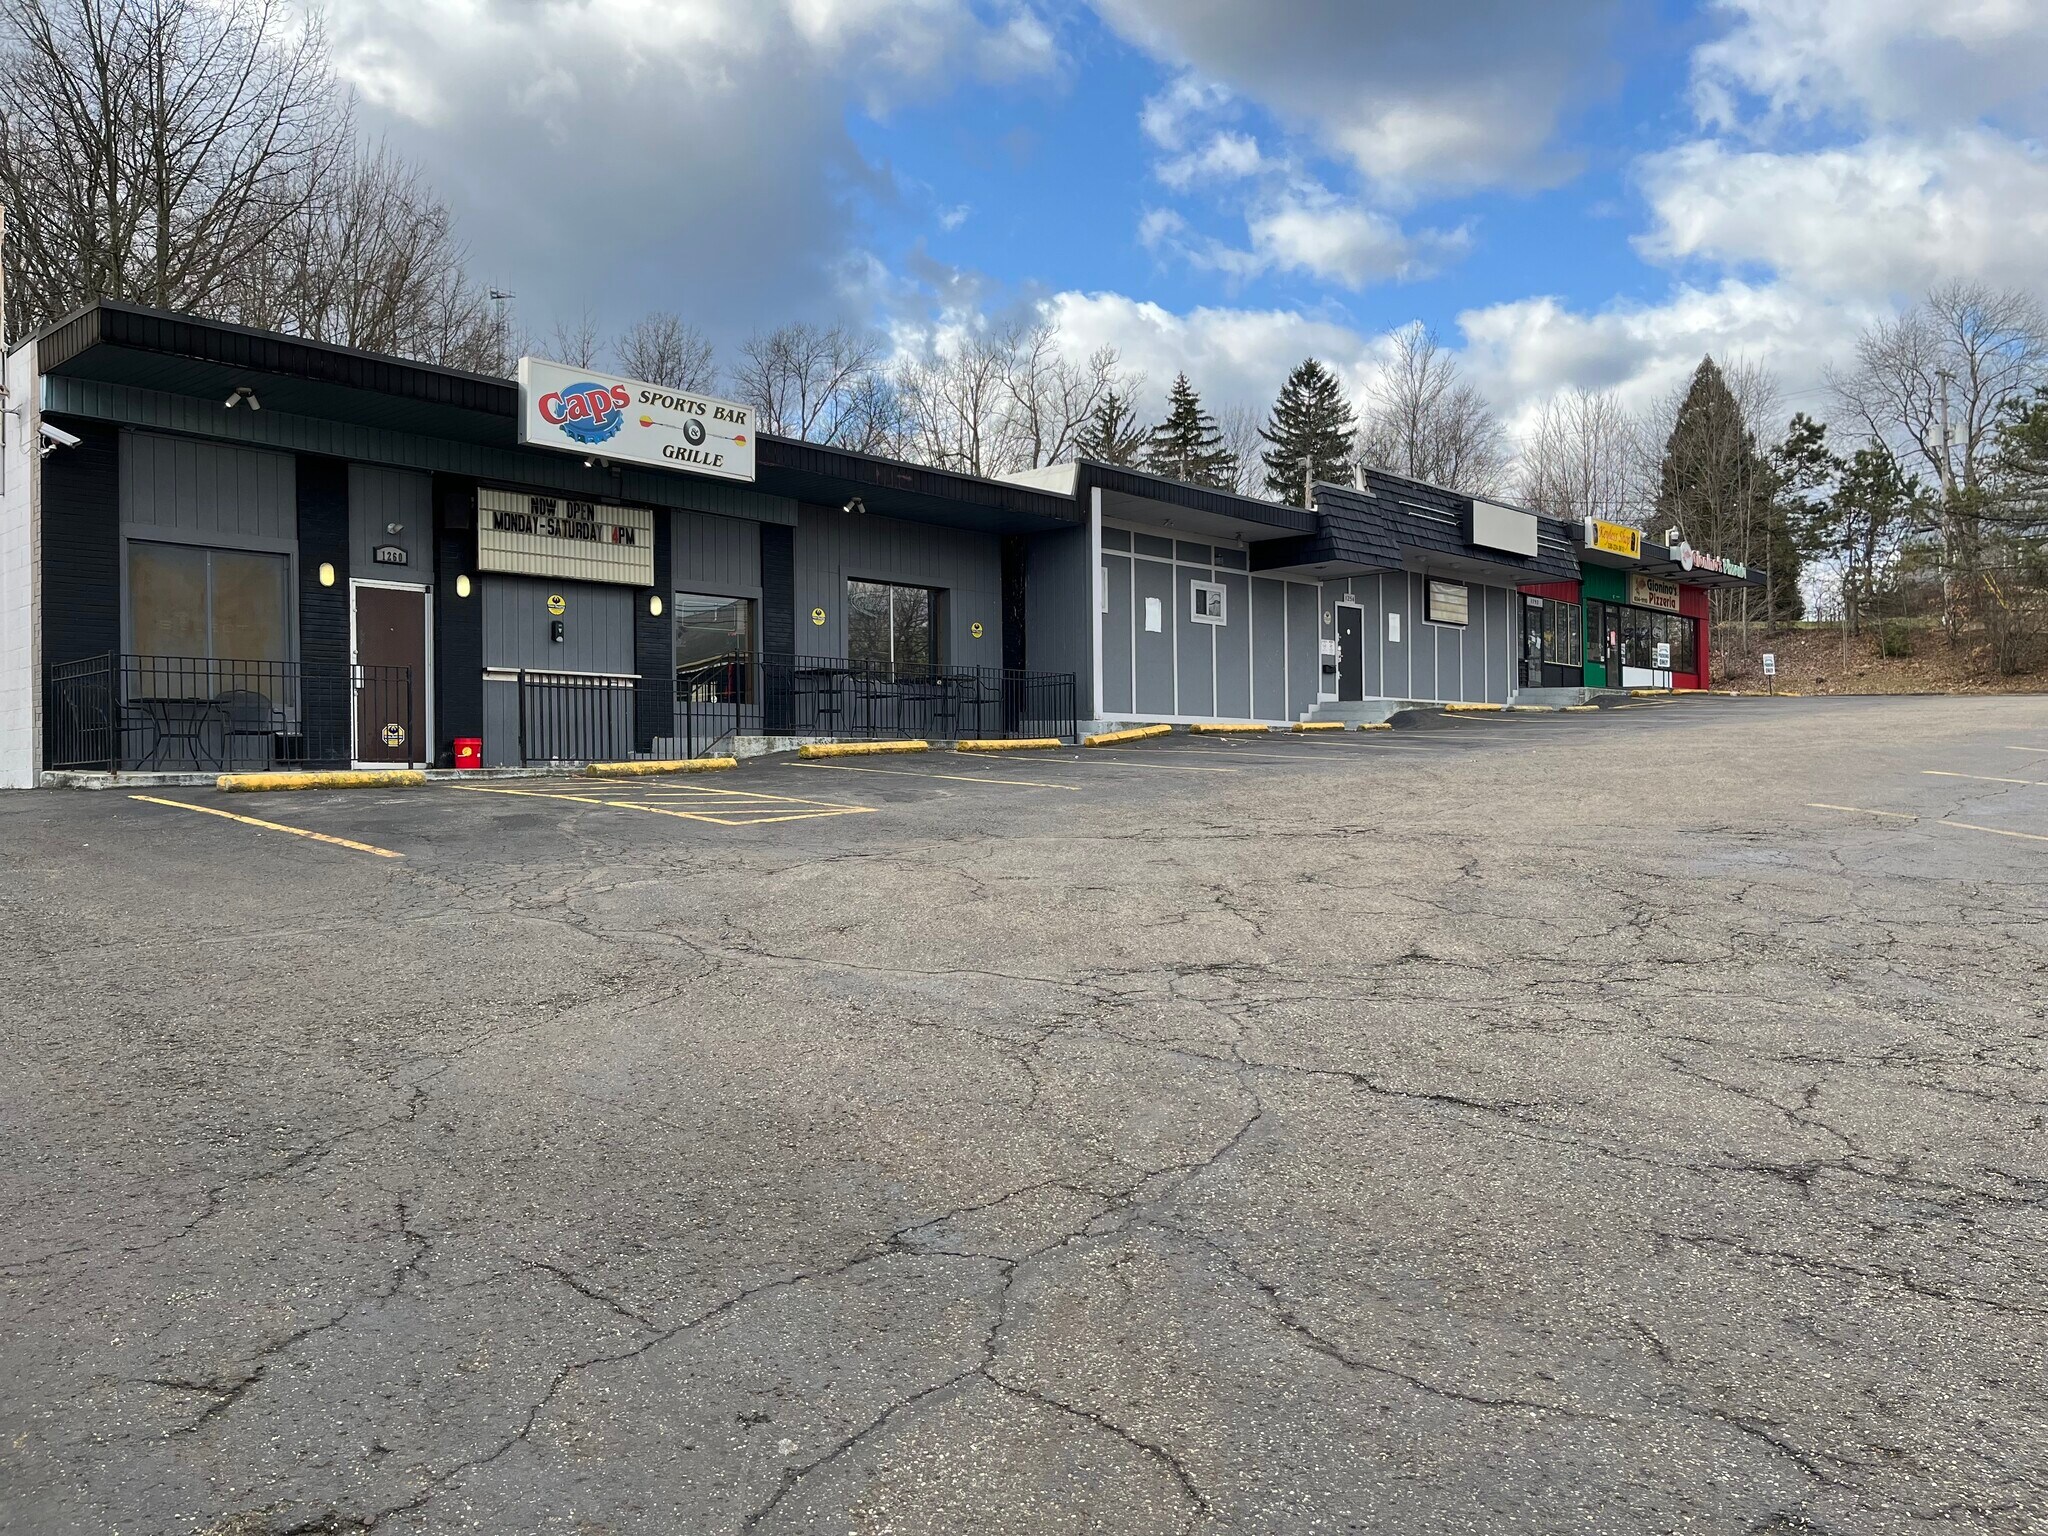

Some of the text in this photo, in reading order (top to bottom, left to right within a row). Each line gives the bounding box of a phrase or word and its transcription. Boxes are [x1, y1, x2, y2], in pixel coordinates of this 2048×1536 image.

[538, 384, 631, 426] Caps
[638, 390, 747, 425] SPORTS BAR
[662, 444, 724, 468] GRILLE
[530, 497, 595, 522] NOW OPEN
[493, 511, 636, 545] MONDAY-SATURDAY 4PM
[382, 550, 403, 562] 1260
[1646, 578, 1678, 597] Gionino's
[1648, 591, 1676, 609] Pizzeria
